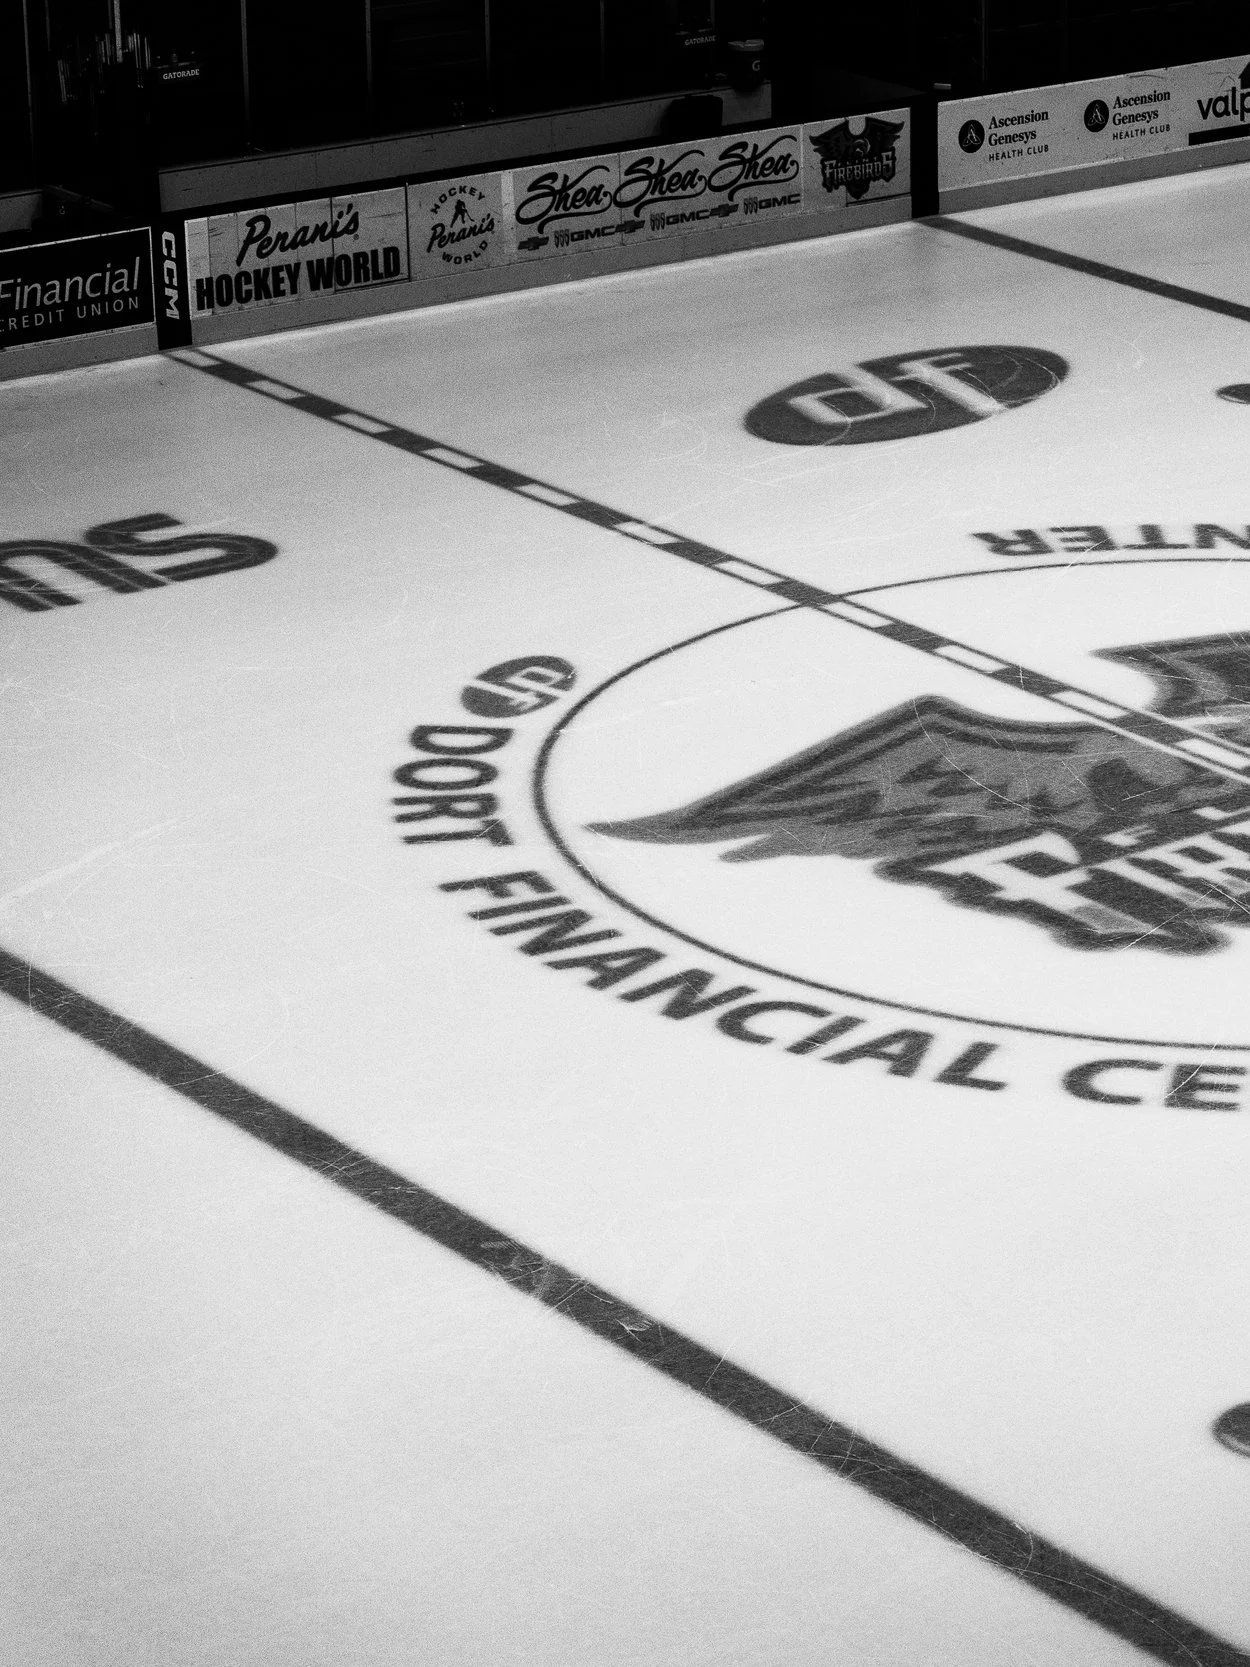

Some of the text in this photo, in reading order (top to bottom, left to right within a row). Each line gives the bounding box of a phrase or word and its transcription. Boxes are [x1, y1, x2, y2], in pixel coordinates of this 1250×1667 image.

[163, 69, 200, 80] GATORADE
[751, 60, 761, 72] G
[1112, 89, 1171, 109] Ascension
[988, 110, 1049, 130] Ascension
[1112, 108, 1159, 126] Genesys
[988, 128, 1037, 147] Genesys
[1112, 123, 1171, 141] HEALTH CLUB
[988, 144, 1049, 162] HEALTH CLUB
[515, 134, 800, 235] Shea Shea Shea
[430, 185, 486, 215] HOCKEY
[570, 193, 801, 242] GMC GMC GMC
[236, 203, 360, 267] Perani's
[426, 213, 495, 253] Perani's
[442, 240, 488, 265] WORLD
[0, 256, 140, 311] Financial
[161, 231, 180, 320] CCM
[196, 246, 401, 311] HOCKEY WORLD
[76, 296, 139, 319] UNION
[392, 724, 514, 846] DORT
[437, 868, 1009, 1091] FINANCIAL
